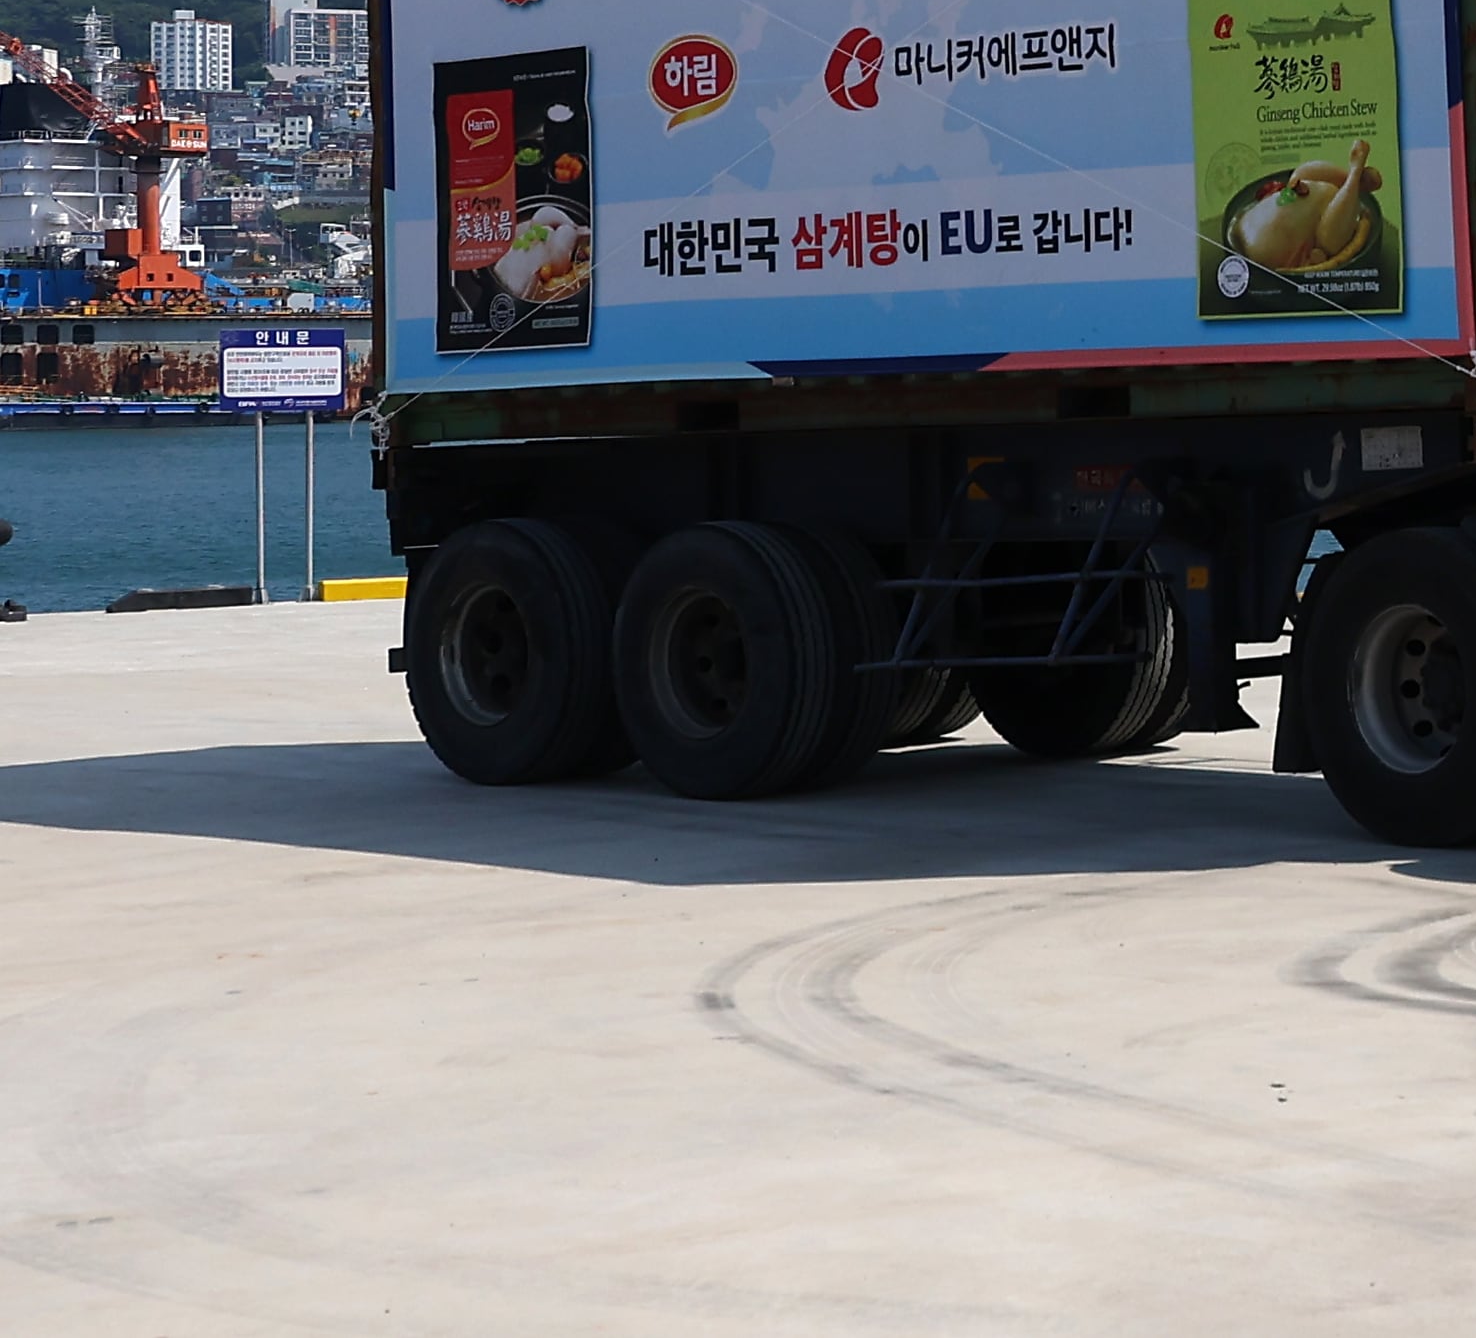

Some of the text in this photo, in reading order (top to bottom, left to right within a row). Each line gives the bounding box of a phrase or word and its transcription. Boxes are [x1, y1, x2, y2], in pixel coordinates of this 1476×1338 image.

[664, 54, 717, 97] 하림
[895, 23, 1115, 85] 마니커에프앤지
[467, 118, 495, 131] Harim
[1257, 99, 1378, 124] Ginseng Chicken Stew
[643, 207, 1133, 277] 대한민국 삼계탕이 EU로 갑니다!
